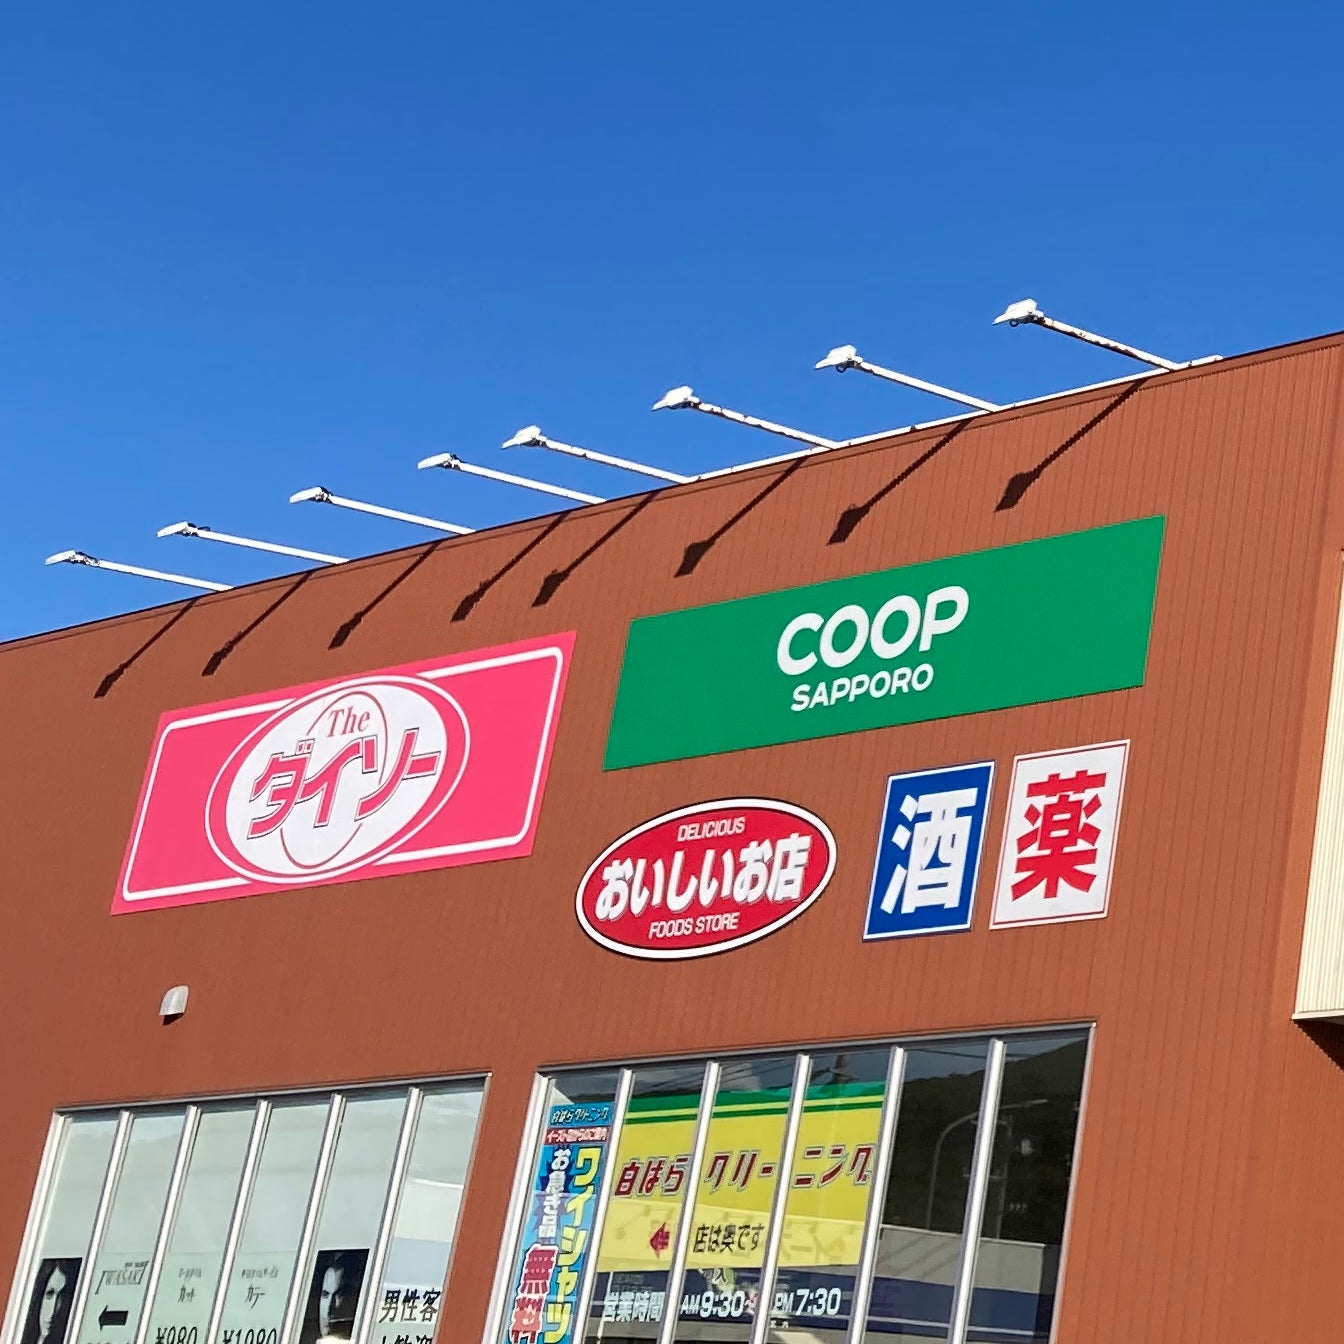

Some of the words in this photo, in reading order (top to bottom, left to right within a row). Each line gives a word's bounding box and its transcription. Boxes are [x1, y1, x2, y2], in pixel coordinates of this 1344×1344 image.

[776, 585, 970, 676] COOP
[790, 663, 934, 712] SAPPORO
[326, 705, 371, 738] The
[246, 727, 442, 840] ダイソー
[676, 815, 746, 842] DELICIOUS
[879, 787, 979, 915] 酒
[1010, 769, 1108, 903] 薬
[594, 832, 813, 922] おいしいお店
[648, 917, 694, 939] FOODS
[695, 911, 741, 933] STORE
[543, 1147, 602, 1344] ワイシャツ
[693, 1222, 765, 1253] 店は奥です
[378, 1287, 441, 1324] 男性客
[602, 1291, 667, 1323] 営業時間
